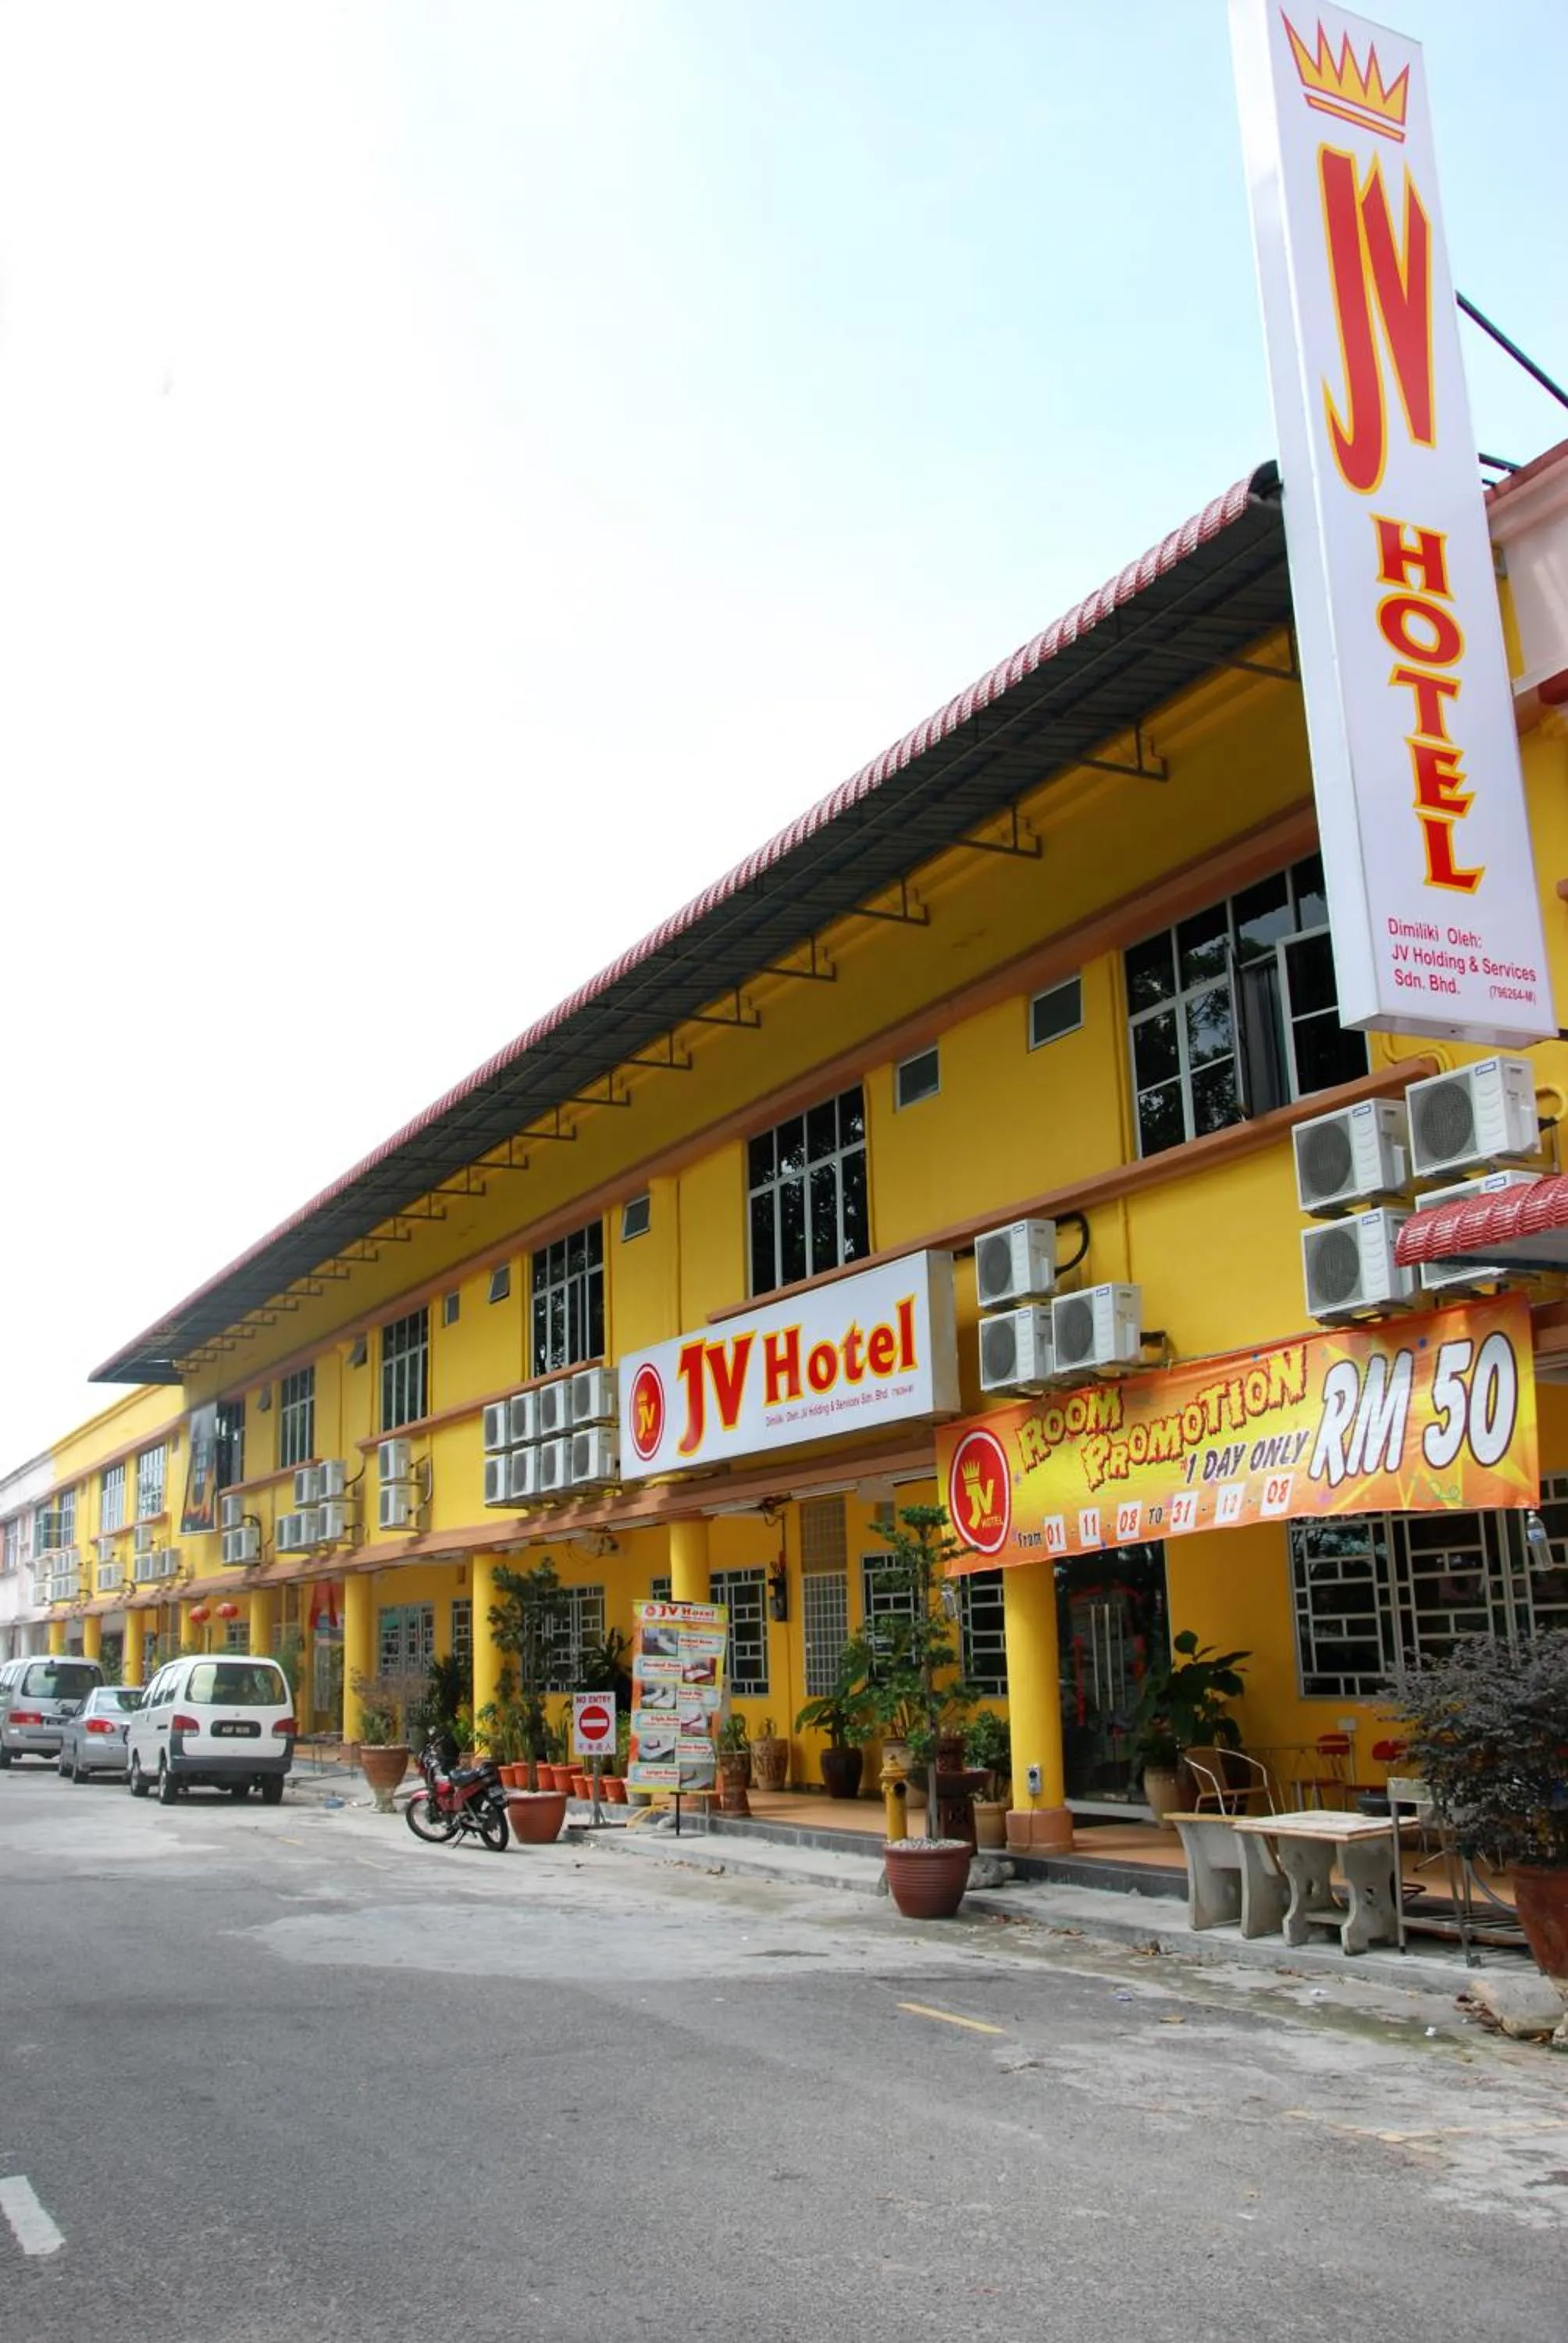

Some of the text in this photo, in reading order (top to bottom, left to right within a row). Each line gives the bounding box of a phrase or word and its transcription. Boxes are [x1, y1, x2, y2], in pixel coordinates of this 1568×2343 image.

[1317, 142, 1436, 495] JV
[1369, 512, 1485, 895] HOTEL
[1388, 918, 1482, 948] Dimiliki Oleh:
[1392, 944, 1537, 982] JV Holding & Services
[1394, 968, 1426, 990] Sdn.
[1430, 974, 1460, 994] Bhd.
[675, 1292, 919, 1458] JV Hotel
[1016, 1385, 1124, 1474] ROOM
[1080, 1344, 1307, 1492] PROMOTION
[1309, 1331, 1518, 1489] RM 50
[1203, 1443, 1247, 1481] DAY
[1249, 1430, 1310, 1473] ONLY
[966, 1478, 995, 1530] JV
[1046, 1524, 1060, 1546] 01
[1082, 1513, 1099, 1537] 11
[1119, 1508, 1139, 1532] 08
[1149, 1507, 1163, 1525] TO
[1172, 1500, 1191, 1524] 31
[1266, 1478, 1288, 1504] 08
[658, 1605, 678, 1617] JV
